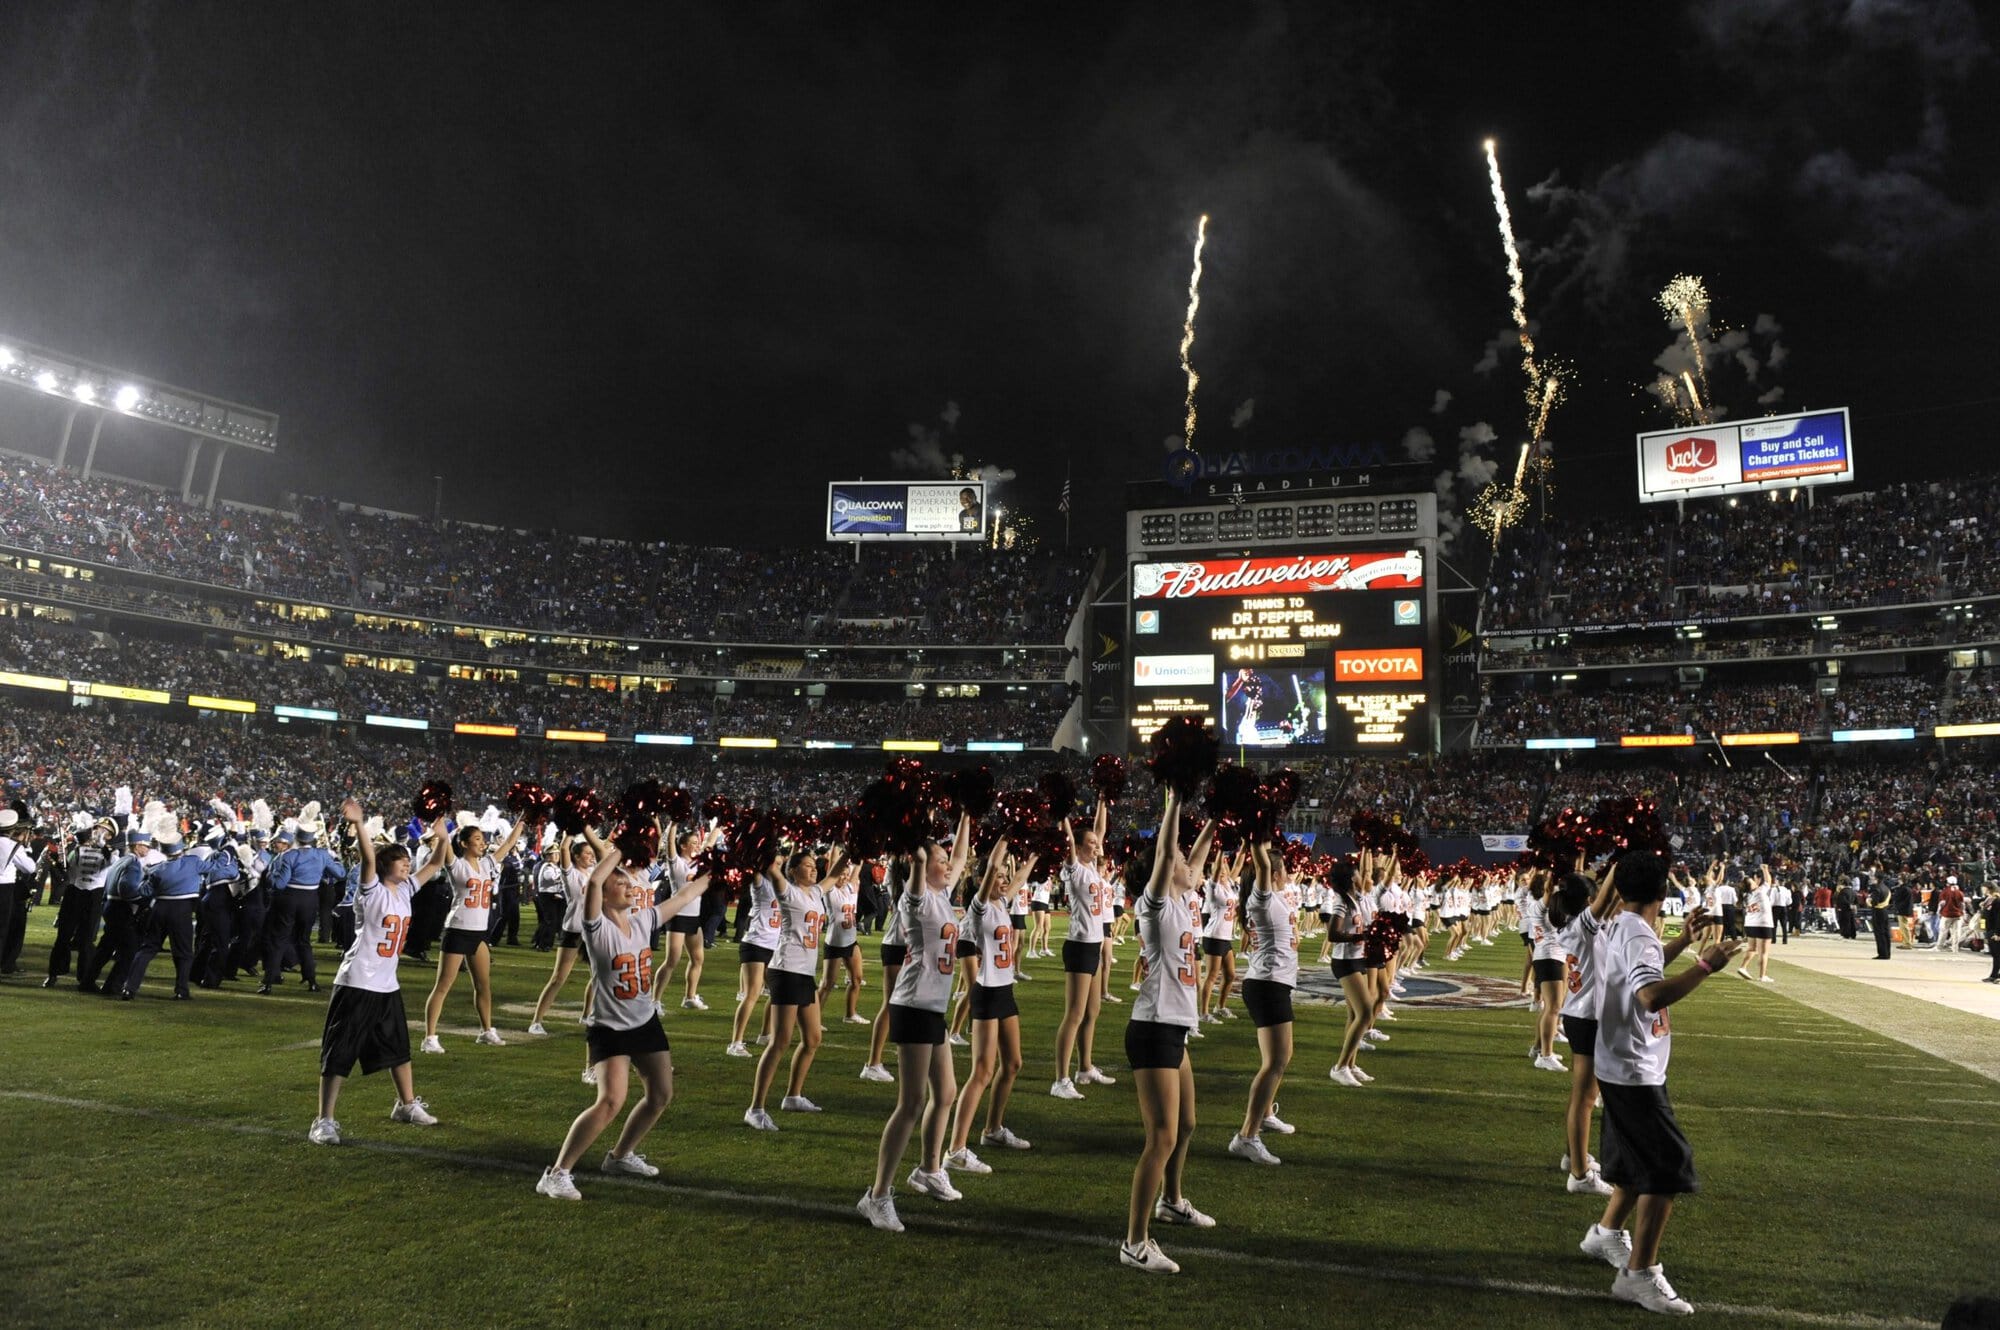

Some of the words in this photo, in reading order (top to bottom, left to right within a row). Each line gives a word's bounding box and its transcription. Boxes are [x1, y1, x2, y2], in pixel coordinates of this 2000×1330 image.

[1761, 442, 1780, 453] Buy
[1783, 438, 1802, 449] and
[1804, 435, 1824, 447] Sell
[1668, 441, 1715, 471] Jack
[1748, 452, 1796, 466] Chargers
[1798, 446, 1839, 461] Tickets!
[911, 489, 959, 497] PALOMAR
[835, 499, 903, 514] QUALCOMM
[911, 506, 958, 514] HEALTH
[848, 514, 892, 522] Innovation
[1160, 556, 1350, 598] Budweiser
[1242, 598, 1285, 610] THANKS
[1288, 597, 1305, 608] TO
[1232, 612, 1253, 625] DR
[1258, 610, 1314, 624] PEPPER
[1211, 626, 1291, 640] HALFTIME
[1299, 624, 1341, 638] SHOW
[1091, 660, 1121, 673] Sprint
[1339, 657, 1419, 674] TOYOTA
[1442, 652, 1476, 666] Sprint
[1623, 737, 1658, 745] WELLS
[1659, 736, 1693, 744] FARGO
